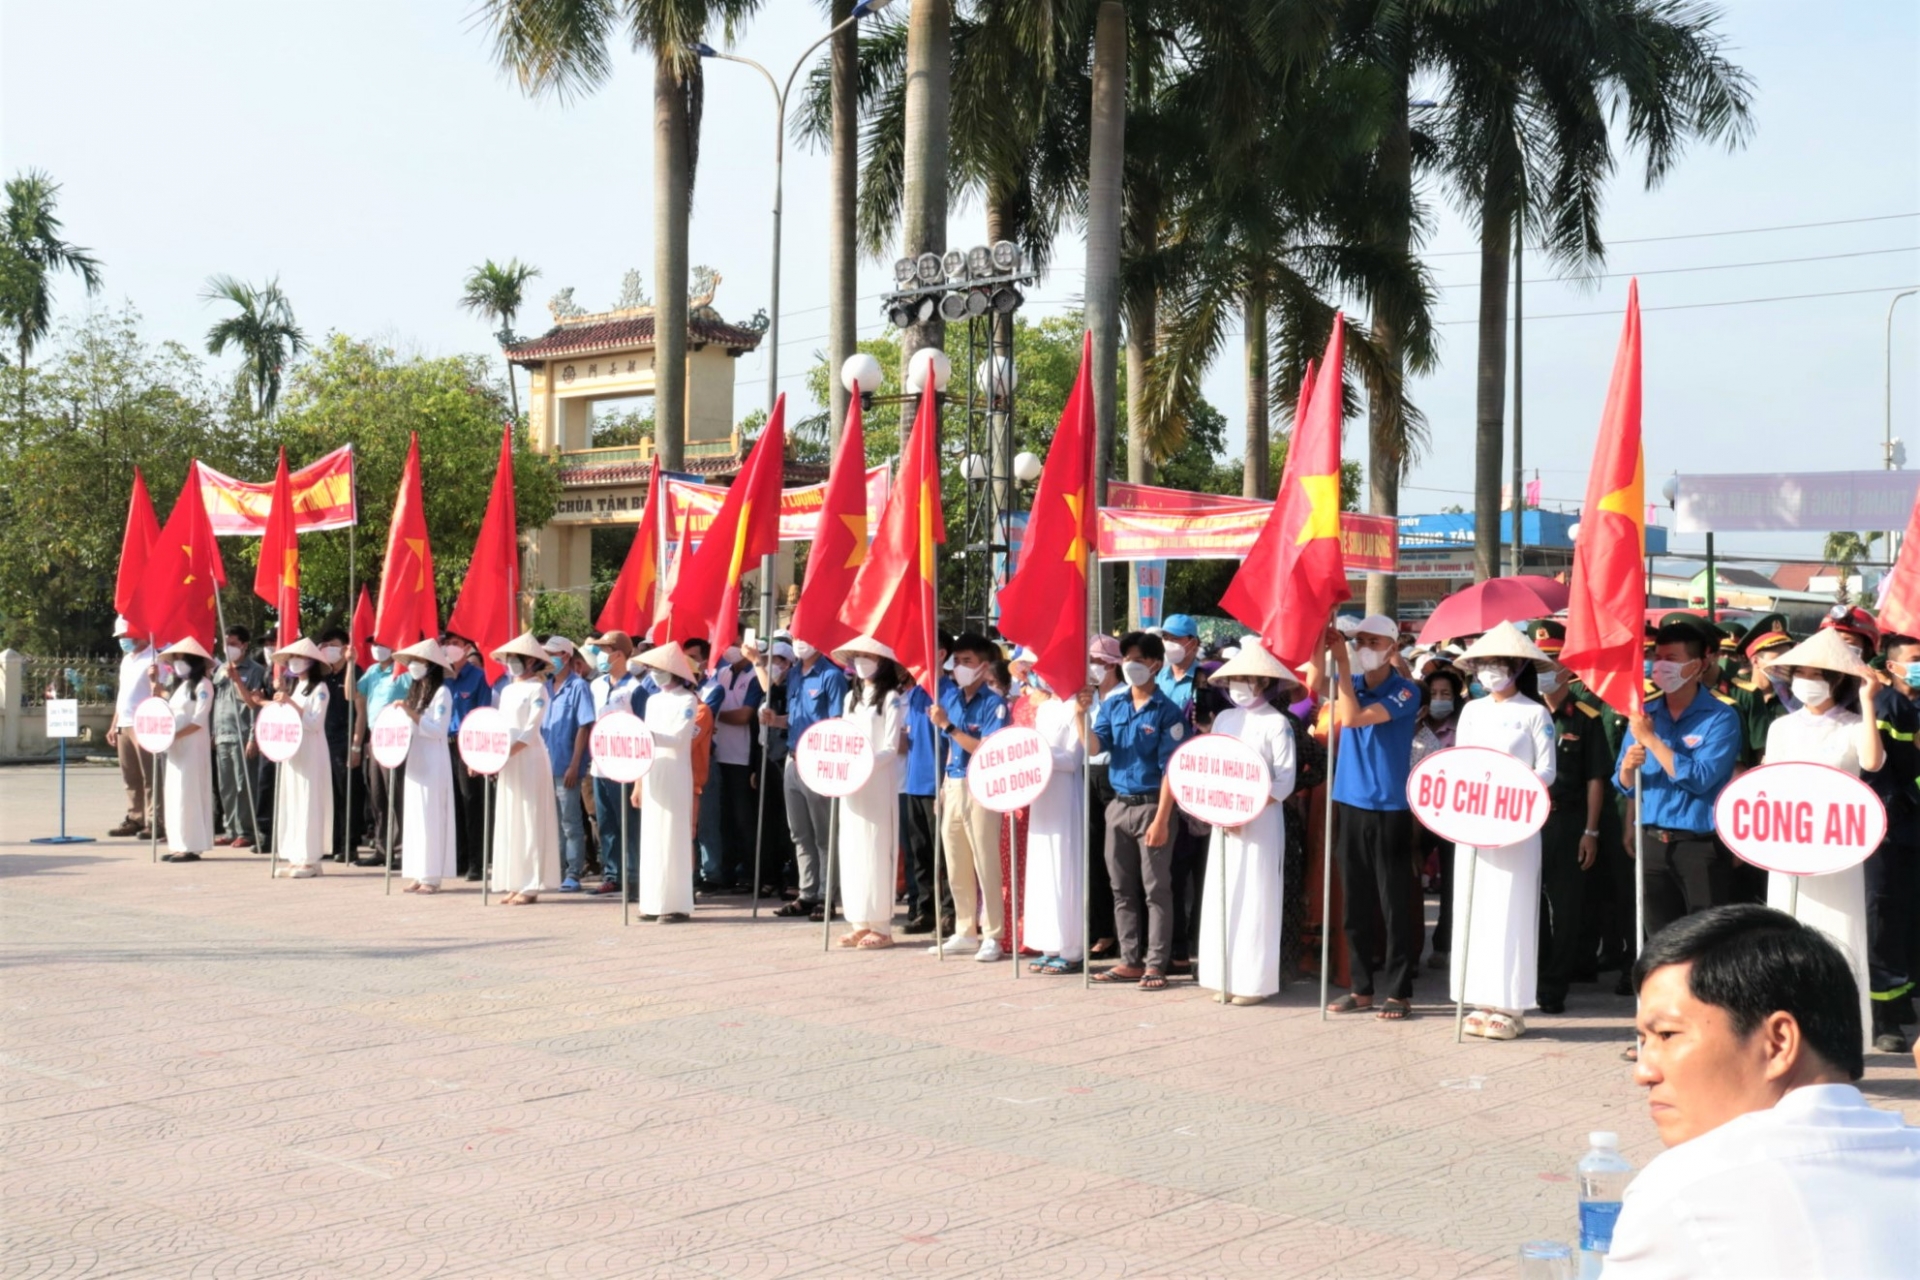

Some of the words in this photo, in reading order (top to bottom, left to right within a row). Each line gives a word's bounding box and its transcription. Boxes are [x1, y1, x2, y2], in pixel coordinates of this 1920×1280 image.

[557, 495, 593, 513] CHÙA
[597, 494, 628, 511] TÂM
[610, 731, 632, 758] NÔNG
[979, 748, 1004, 770] LIÊN
[986, 777, 1006, 798] LAO
[1010, 767, 1042, 792] ĐỘNG
[1418, 769, 1447, 816] BỘ
[1452, 771, 1491, 816] CHỈ
[1494, 786, 1538, 824] HUY
[1732, 790, 1813, 844] CÔNG
[1824, 802, 1866, 847] AN
